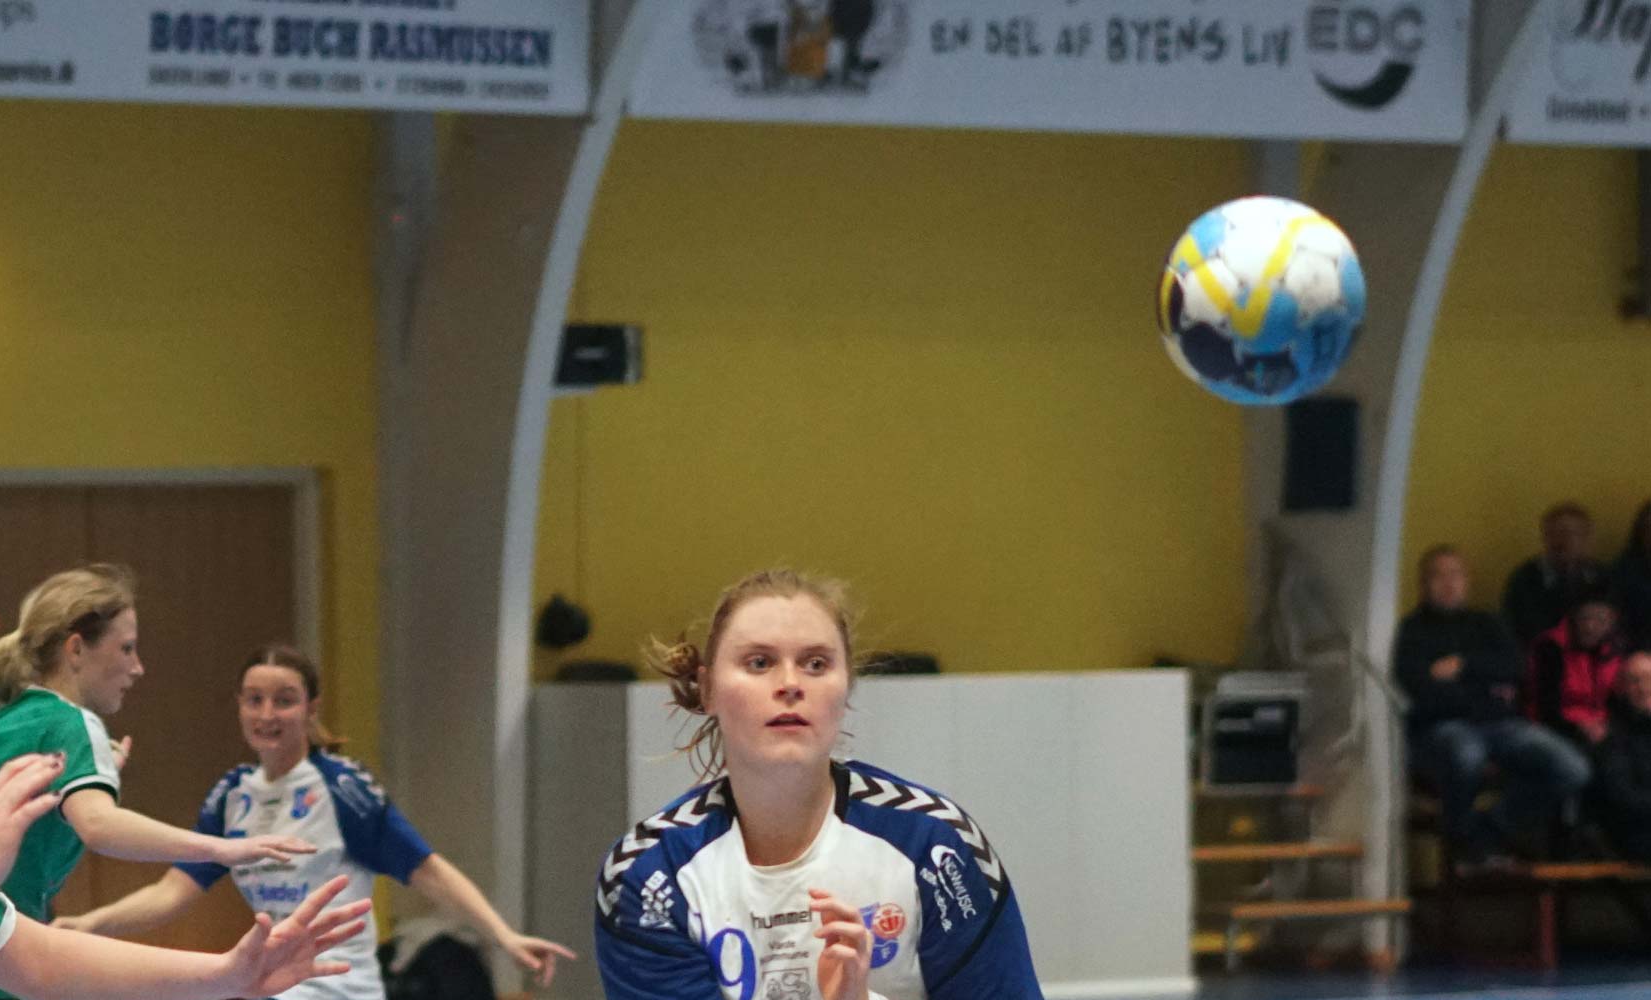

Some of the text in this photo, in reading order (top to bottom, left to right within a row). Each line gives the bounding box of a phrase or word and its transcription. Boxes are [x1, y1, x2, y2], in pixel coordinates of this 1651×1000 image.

[273, 17, 360, 60] BUCH
[368, 21, 552, 68] RASMUSSEN
[930, 16, 1293, 67] EN DEL AF BYENS LIV
[1306, 5, 1425, 56] EDC
[750, 909, 812, 929] hummel
